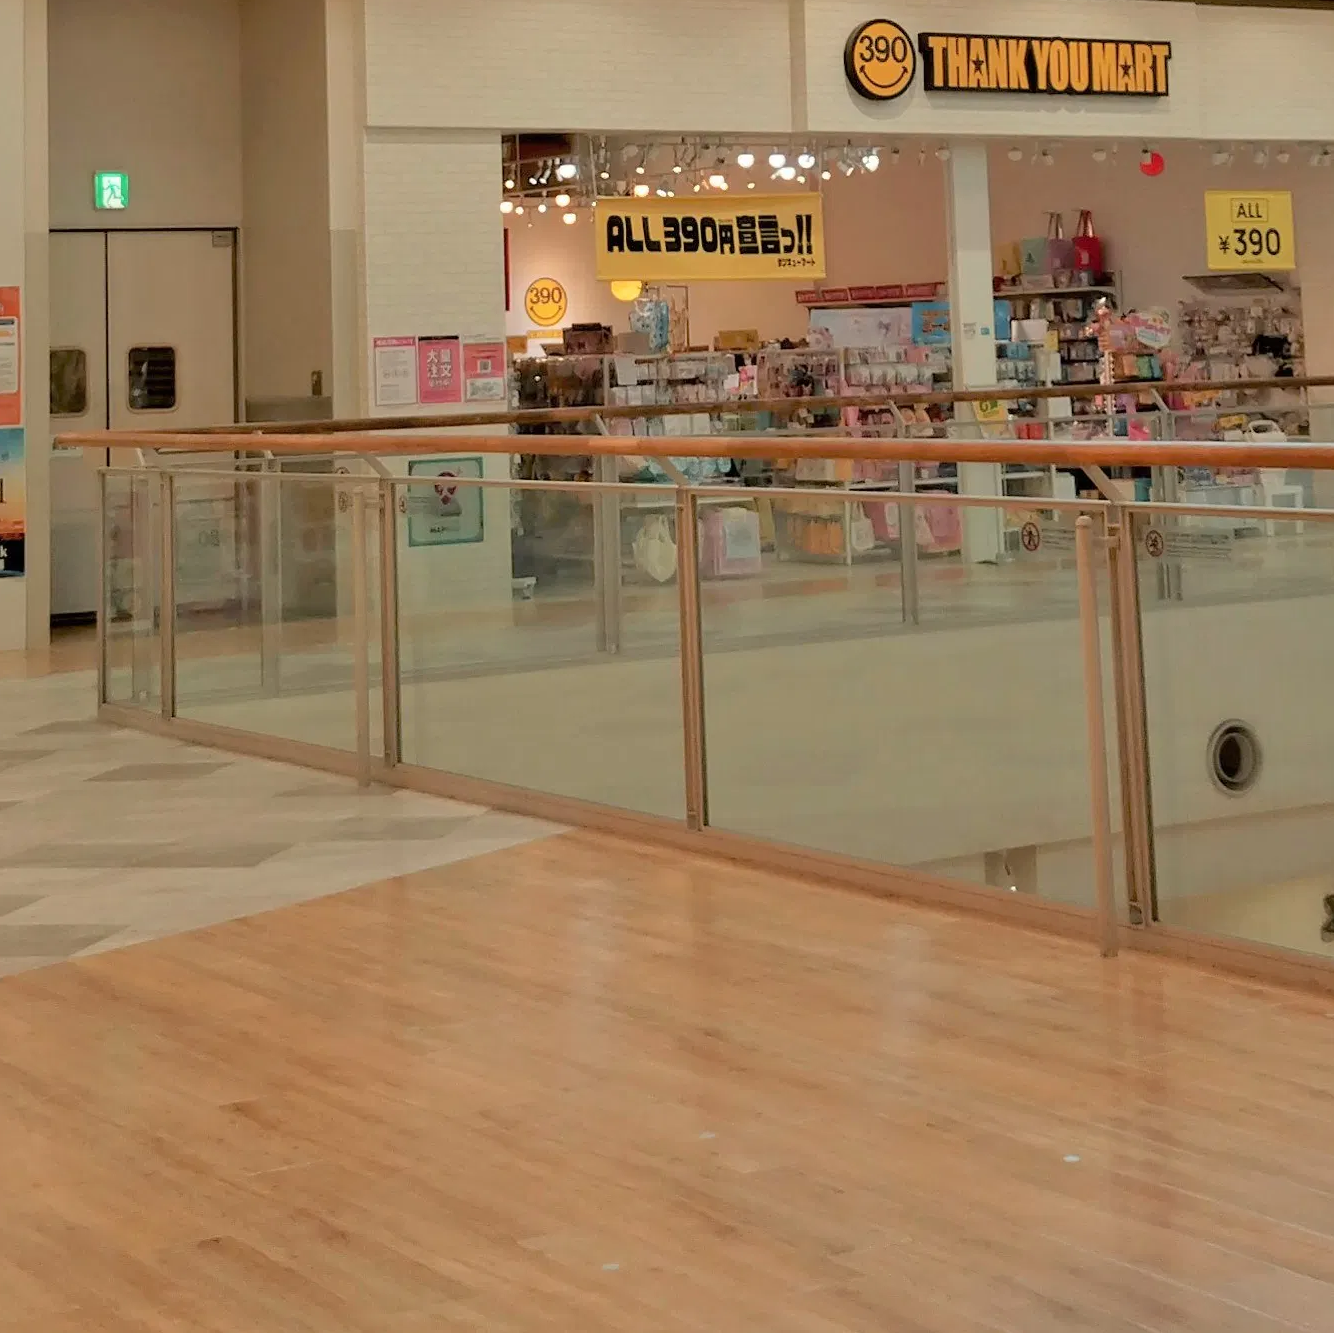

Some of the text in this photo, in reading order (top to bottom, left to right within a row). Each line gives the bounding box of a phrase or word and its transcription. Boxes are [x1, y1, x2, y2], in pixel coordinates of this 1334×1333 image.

[858, 34, 908, 64] 390
[927, 36, 1169, 94] THANK YOU MART
[1236, 202, 1263, 219] ALL
[606, 214, 661, 253] ALL
[1219, 228, 1281, 256] ¥390
[530, 286, 563, 305] 390
